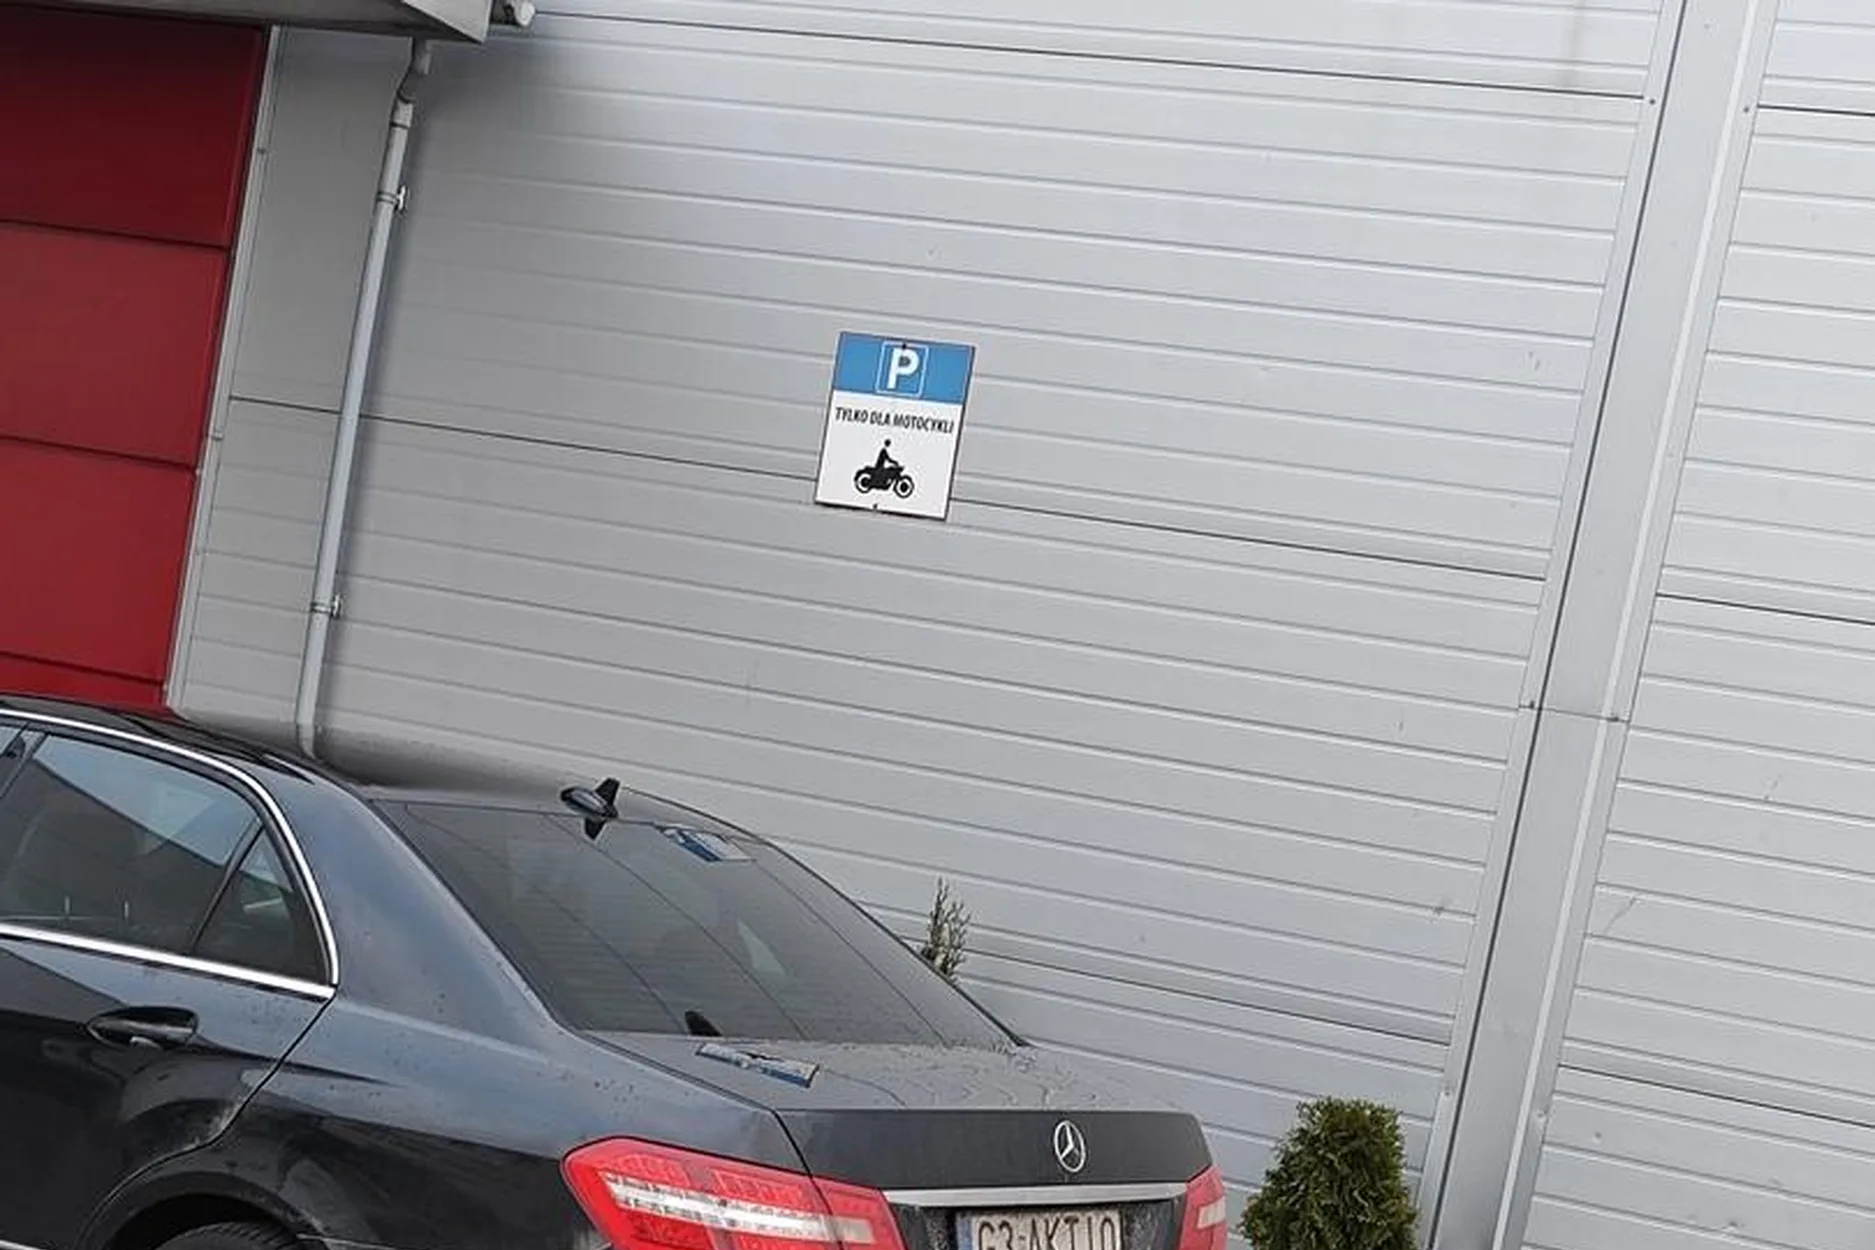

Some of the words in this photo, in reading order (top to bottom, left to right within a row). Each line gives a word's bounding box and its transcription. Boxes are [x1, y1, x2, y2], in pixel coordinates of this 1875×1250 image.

[887, 347, 920, 390] P
[835, 406, 869, 423] TYLKO
[870, 410, 891, 426] DLA
[893, 413, 955, 434] MOTOCYKLI
